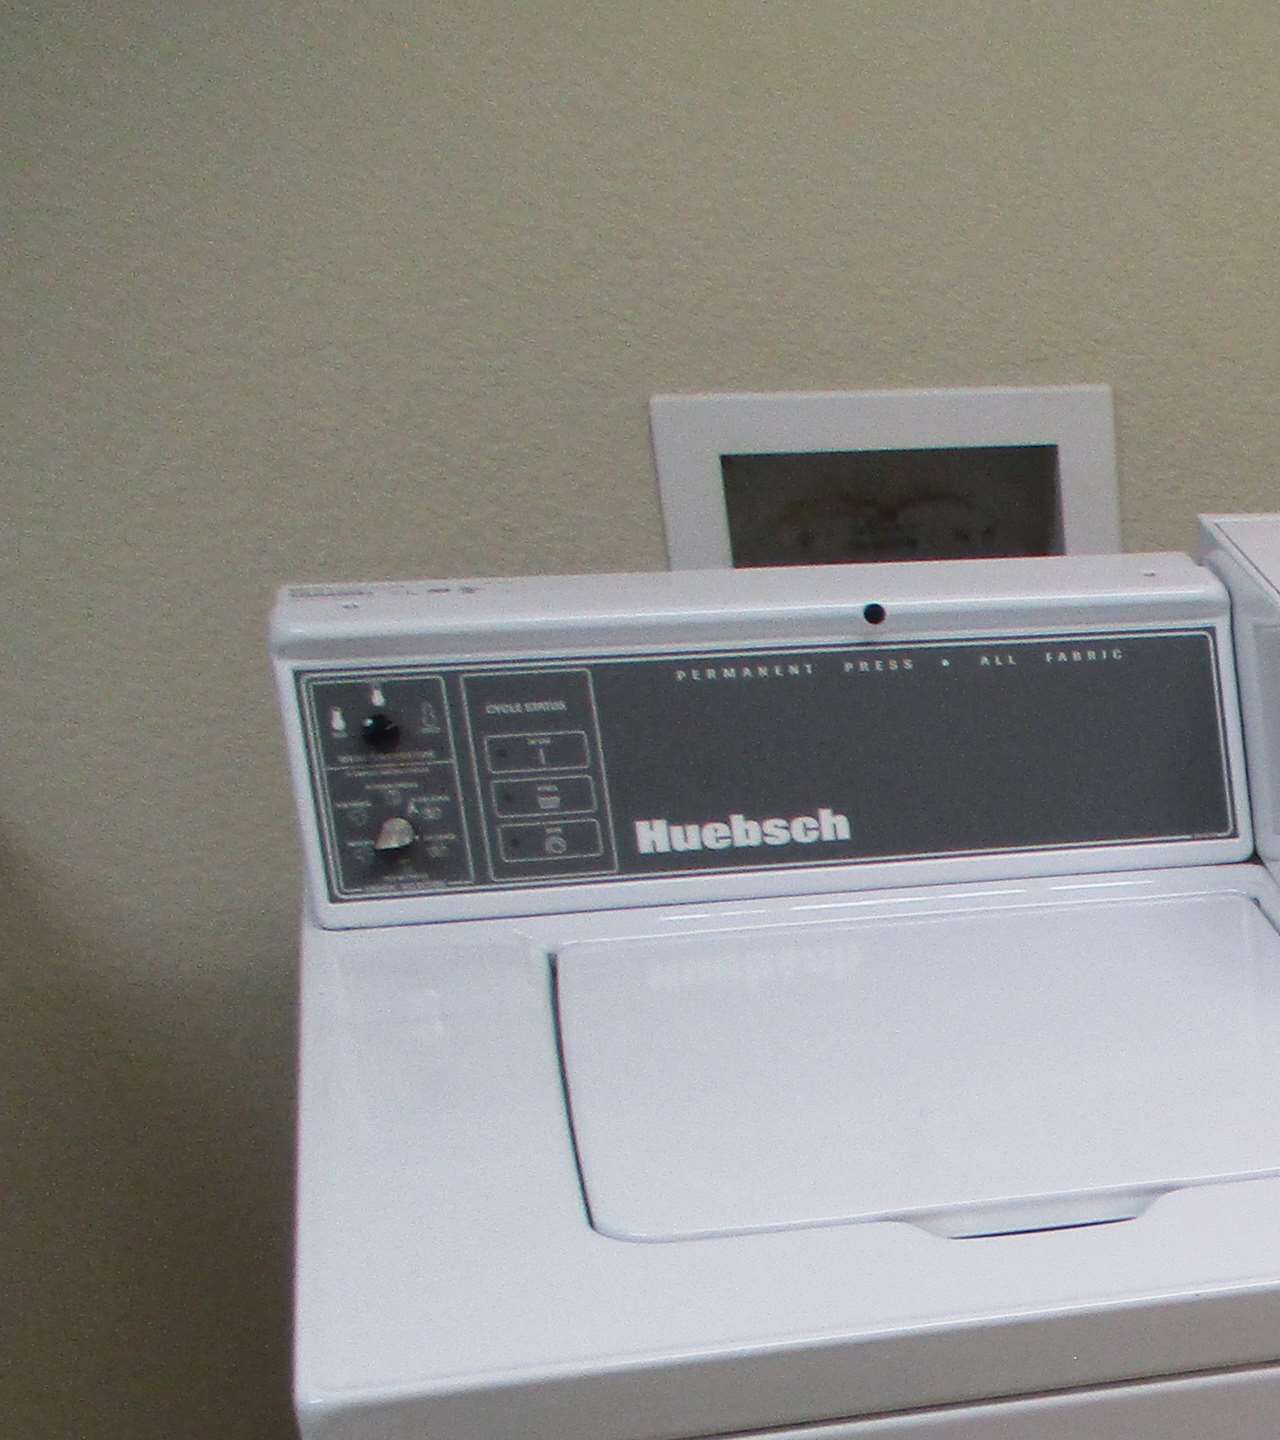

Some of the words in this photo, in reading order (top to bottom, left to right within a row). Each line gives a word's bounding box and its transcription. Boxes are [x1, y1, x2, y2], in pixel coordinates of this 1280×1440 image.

[675, 664, 814, 681] PERMANENT
[843, 658, 914, 673] PRESS
[980, 654, 1017, 666] ALL
[1045, 648, 1123, 663] FABRIC
[634, 808, 852, 855] Huebsch
